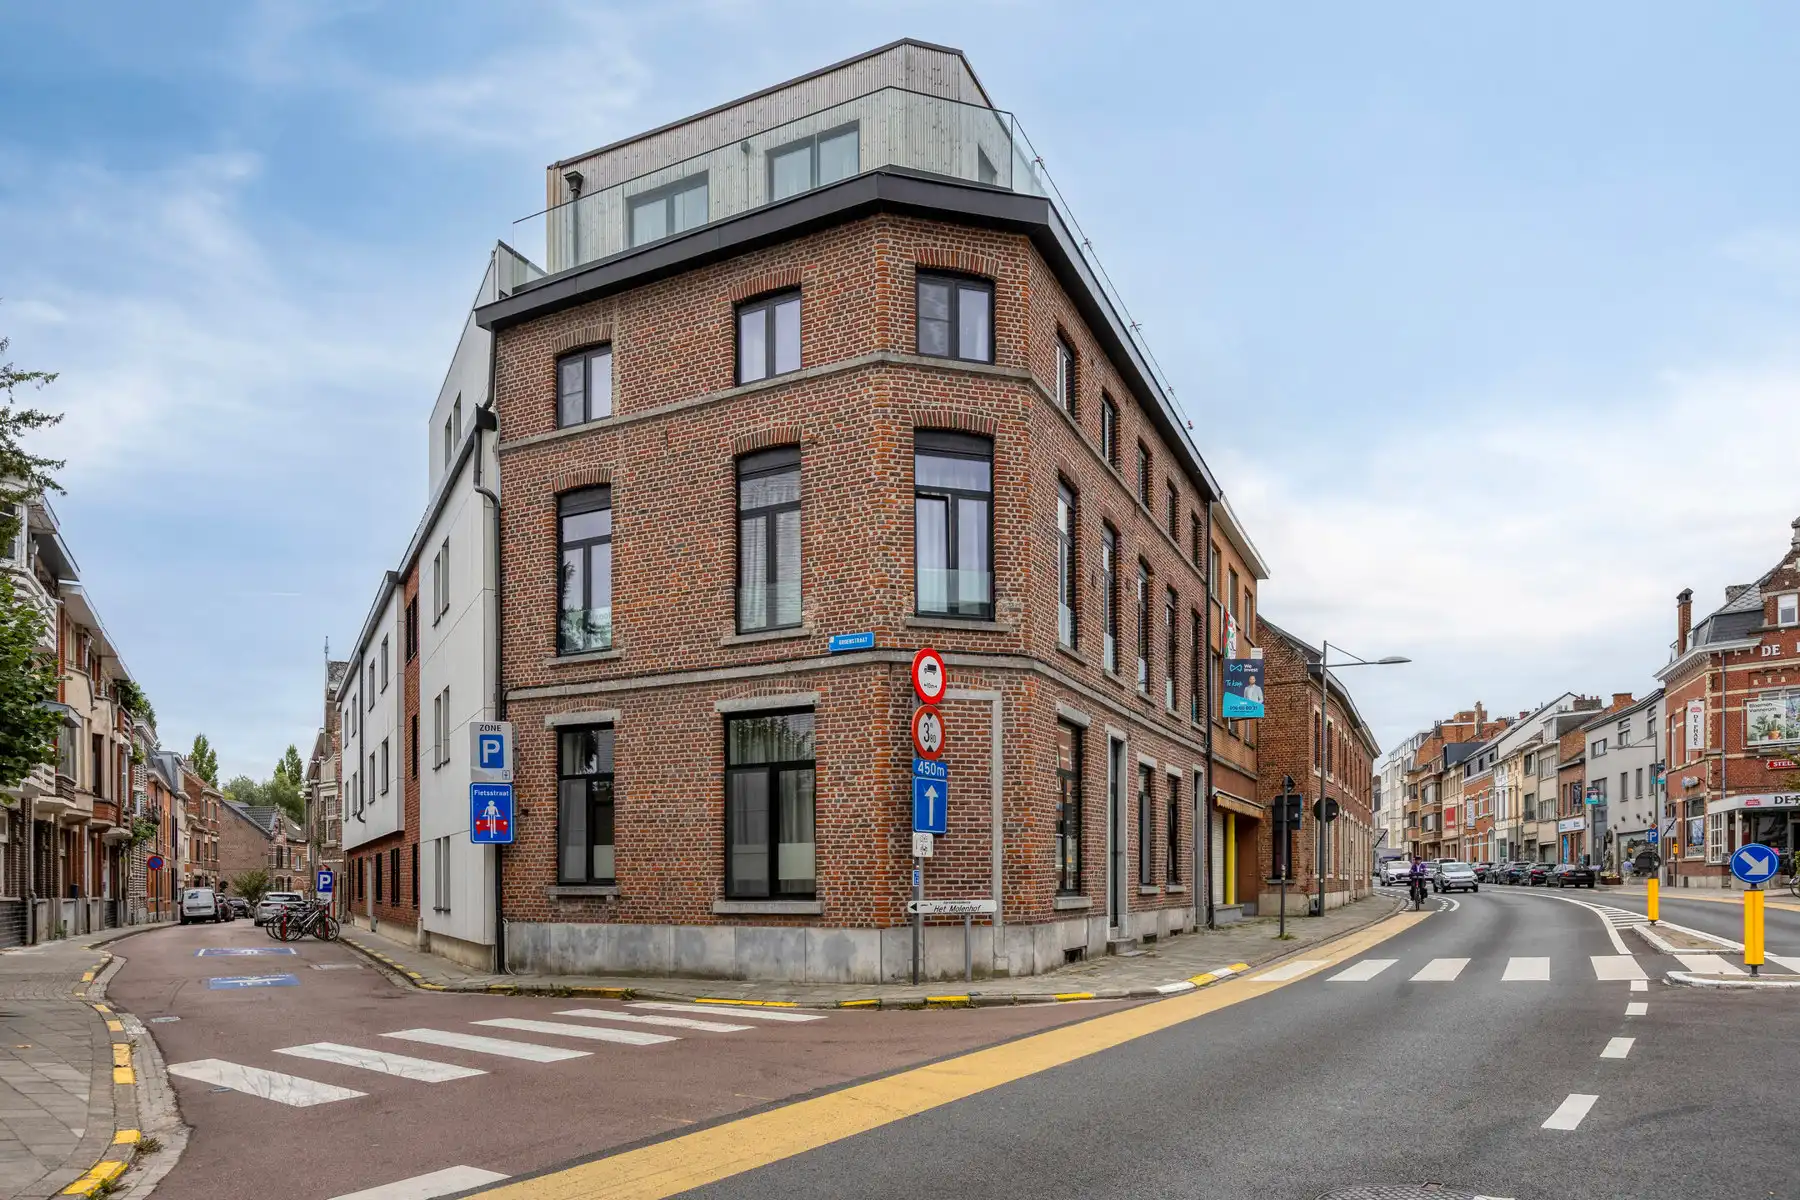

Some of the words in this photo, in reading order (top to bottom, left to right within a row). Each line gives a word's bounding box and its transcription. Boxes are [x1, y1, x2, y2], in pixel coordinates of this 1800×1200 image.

[1761, 644, 1781, 656] DE
[479, 724, 502, 732] ZONE
[923, 722, 930, 742] 3
[930, 734, 937, 744] 80
[482, 739, 500, 763] P
[917, 761, 945, 777] 450m
[1774, 795, 1792, 805] DE
[1649, 831, 1657, 841] P
[319, 874, 332, 890] P
[933, 905, 946, 913] Het
[948, 904, 982, 913] Molenhof
